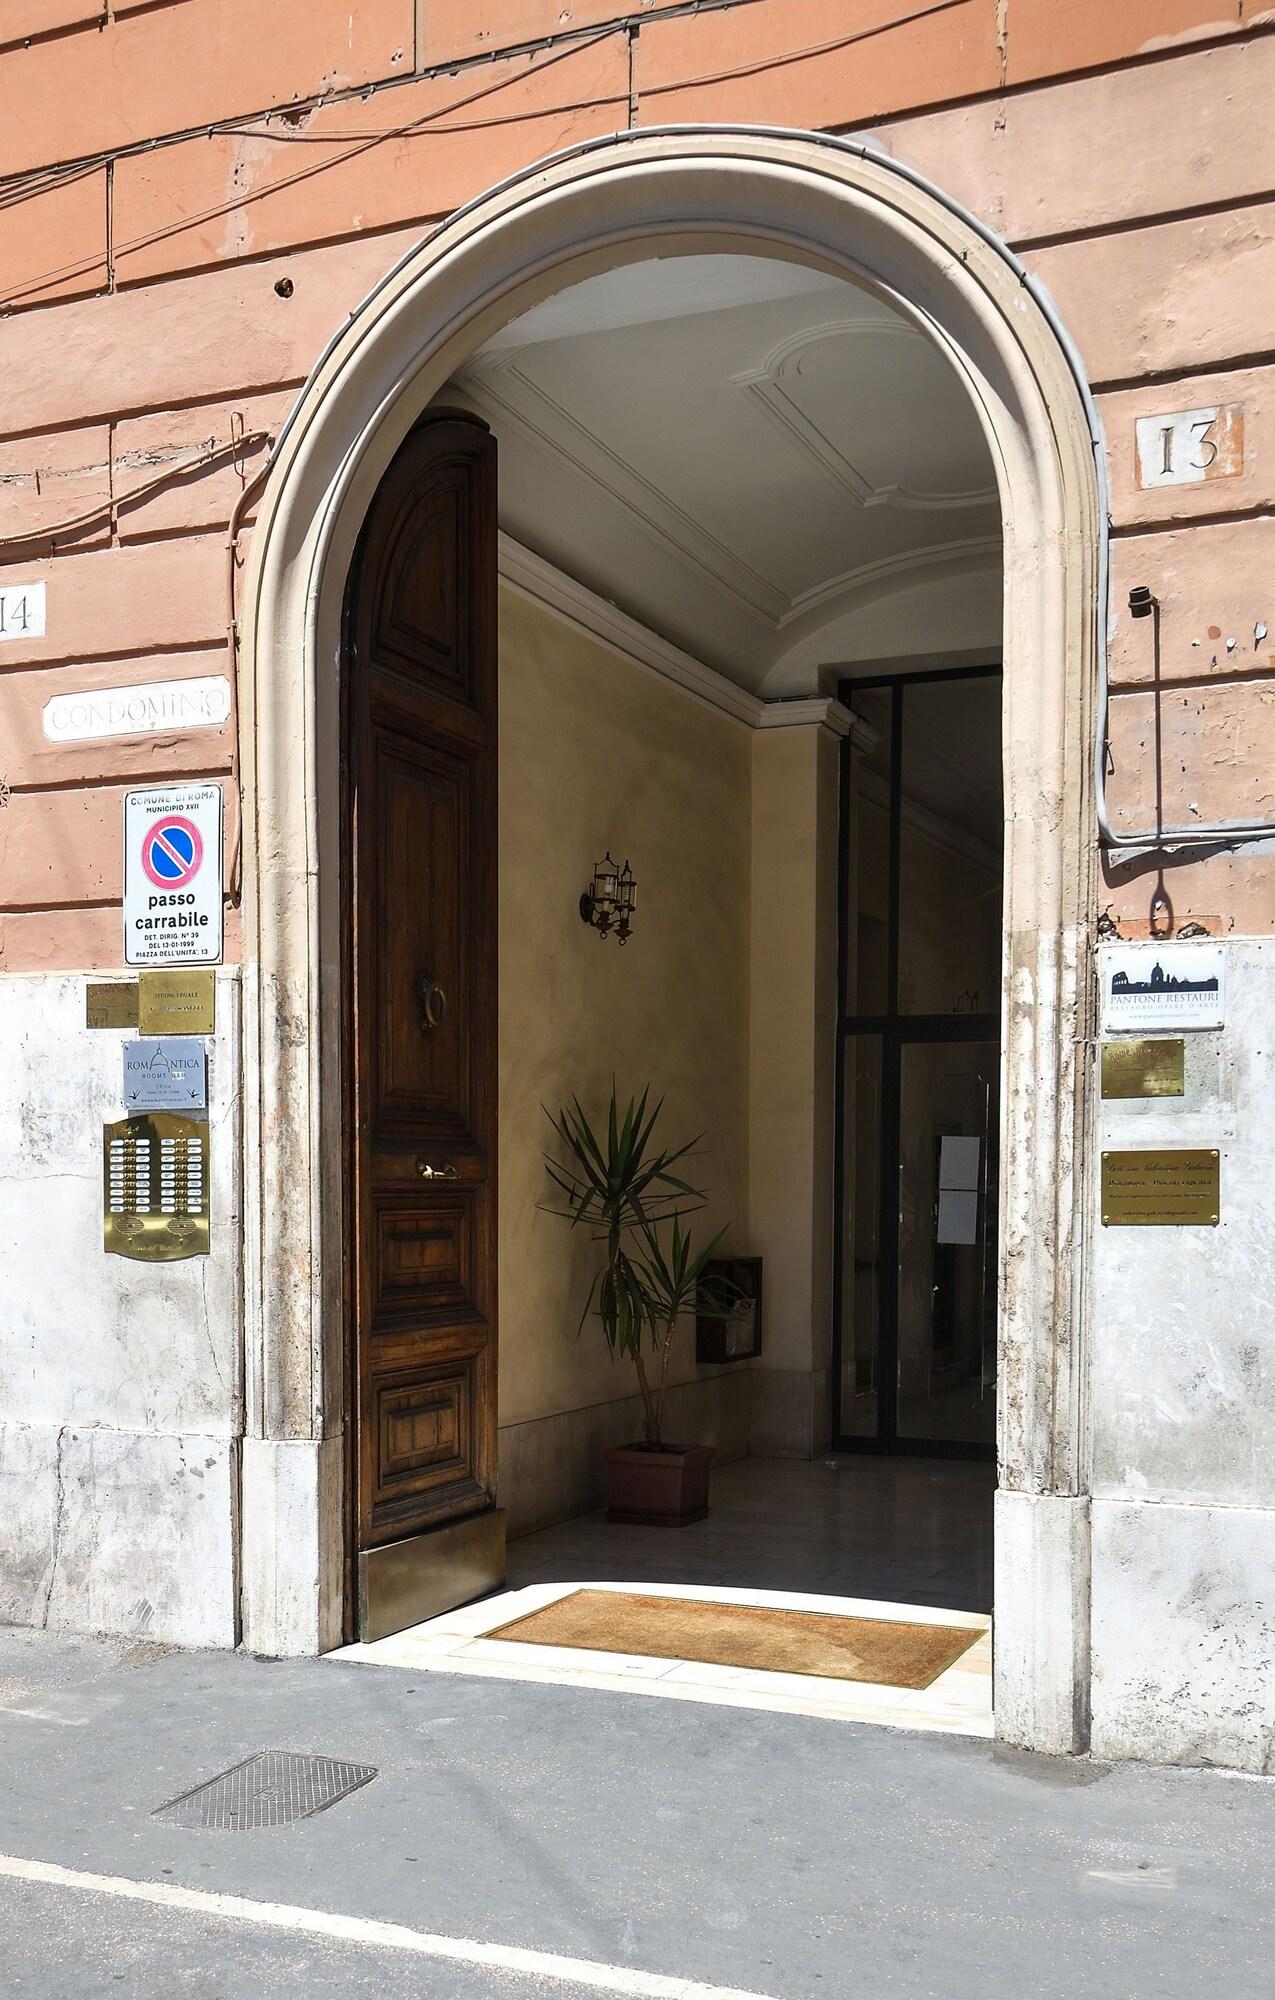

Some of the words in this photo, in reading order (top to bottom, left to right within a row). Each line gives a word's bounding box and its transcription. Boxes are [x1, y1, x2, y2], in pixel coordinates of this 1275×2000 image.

[1159, 419, 1217, 475] 13
[0, 595, 32, 632] 14
[130, 794, 171, 806] COMUNE
[176, 793, 186, 802] DI
[188, 791, 215, 801] ROMA
[146, 804, 184, 813] MUNICIPIO
[186, 803, 199, 811] XVII
[149, 893, 195, 910] passo
[135, 911, 209, 929] carrabile
[162, 940, 195, 949] 13-01-1999
[135, 950, 158, 958] PIAZZA
[1110, 994, 1161, 1005] PANTONE
[1166, 992, 1219, 1003] RESTAURI
[127, 1045, 200, 1073] ROMANTICA
